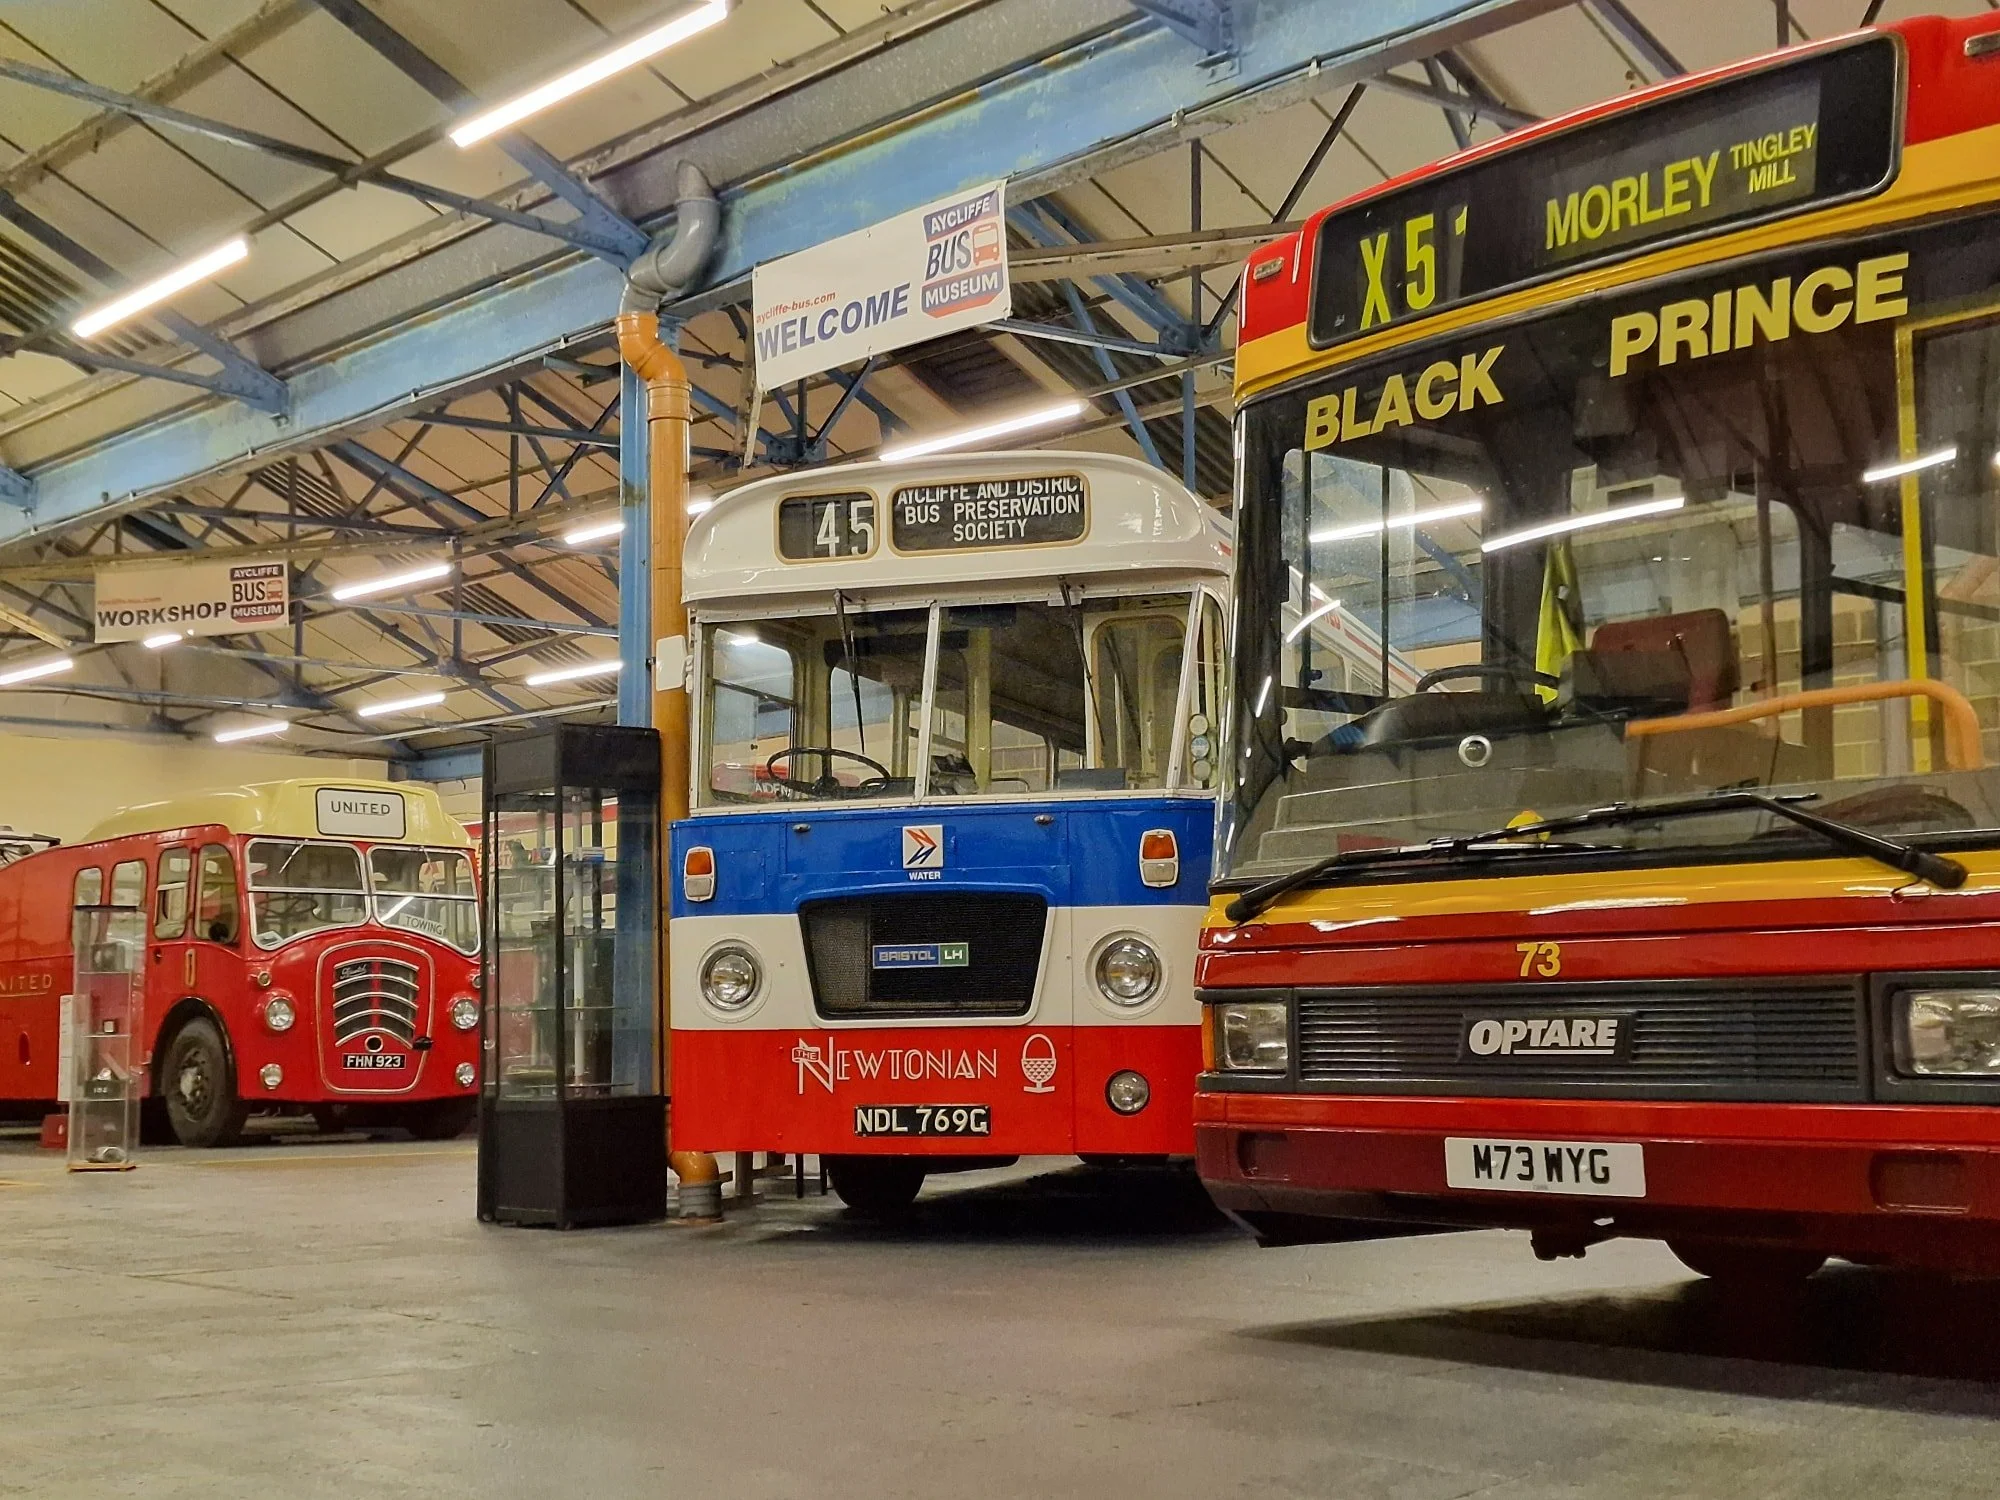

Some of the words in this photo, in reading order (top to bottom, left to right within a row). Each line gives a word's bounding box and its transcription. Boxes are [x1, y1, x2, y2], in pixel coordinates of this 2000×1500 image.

[1730, 122, 1817, 170] TINGLEY
[1749, 159, 1796, 194] MILL
[931, 195, 991, 235] AYCLIFFE
[1546, 150, 1719, 250] MORLEY
[925, 229, 972, 281] BUS
[925, 271, 998, 308] MUSEUM
[756, 290, 836, 324] aycliffe-bus.com
[757, 281, 911, 362] WELCOME
[1304, 345, 1505, 452] BLACK
[1610, 252, 1909, 377] PRINCE
[977, 481, 1010, 499] AND
[905, 504, 940, 525] BUS
[953, 494, 1080, 522] PRESERVATION
[816, 500, 874, 558] 45
[953, 519, 1029, 542] SOCIETY
[233, 566, 280, 578] AYCLIFFE
[232, 581, 266, 603] BUS
[97, 602, 227, 627] WORKSHOP
[232, 605, 282, 618] MUSEUM
[331, 800, 391, 815] UNITED
[908, 871, 941, 881] WATER
[405, 915, 443, 934] TOWING
[878, 950, 936, 961] BRISTOL
[944, 949, 963, 960] LH
[1516, 942, 1561, 977] 73
[1468, 1019, 1618, 1055] OPTARE
[346, 1055, 373, 1067] FHN
[376, 1055, 402, 1067] 923
[796, 1049, 818, 1061] THE
[856, 1108, 909, 1133] NDL
[915, 1108, 988, 1133] 769G
[1473, 1143, 1535, 1181] M73
[1543, 1146, 1611, 1184] WYG
